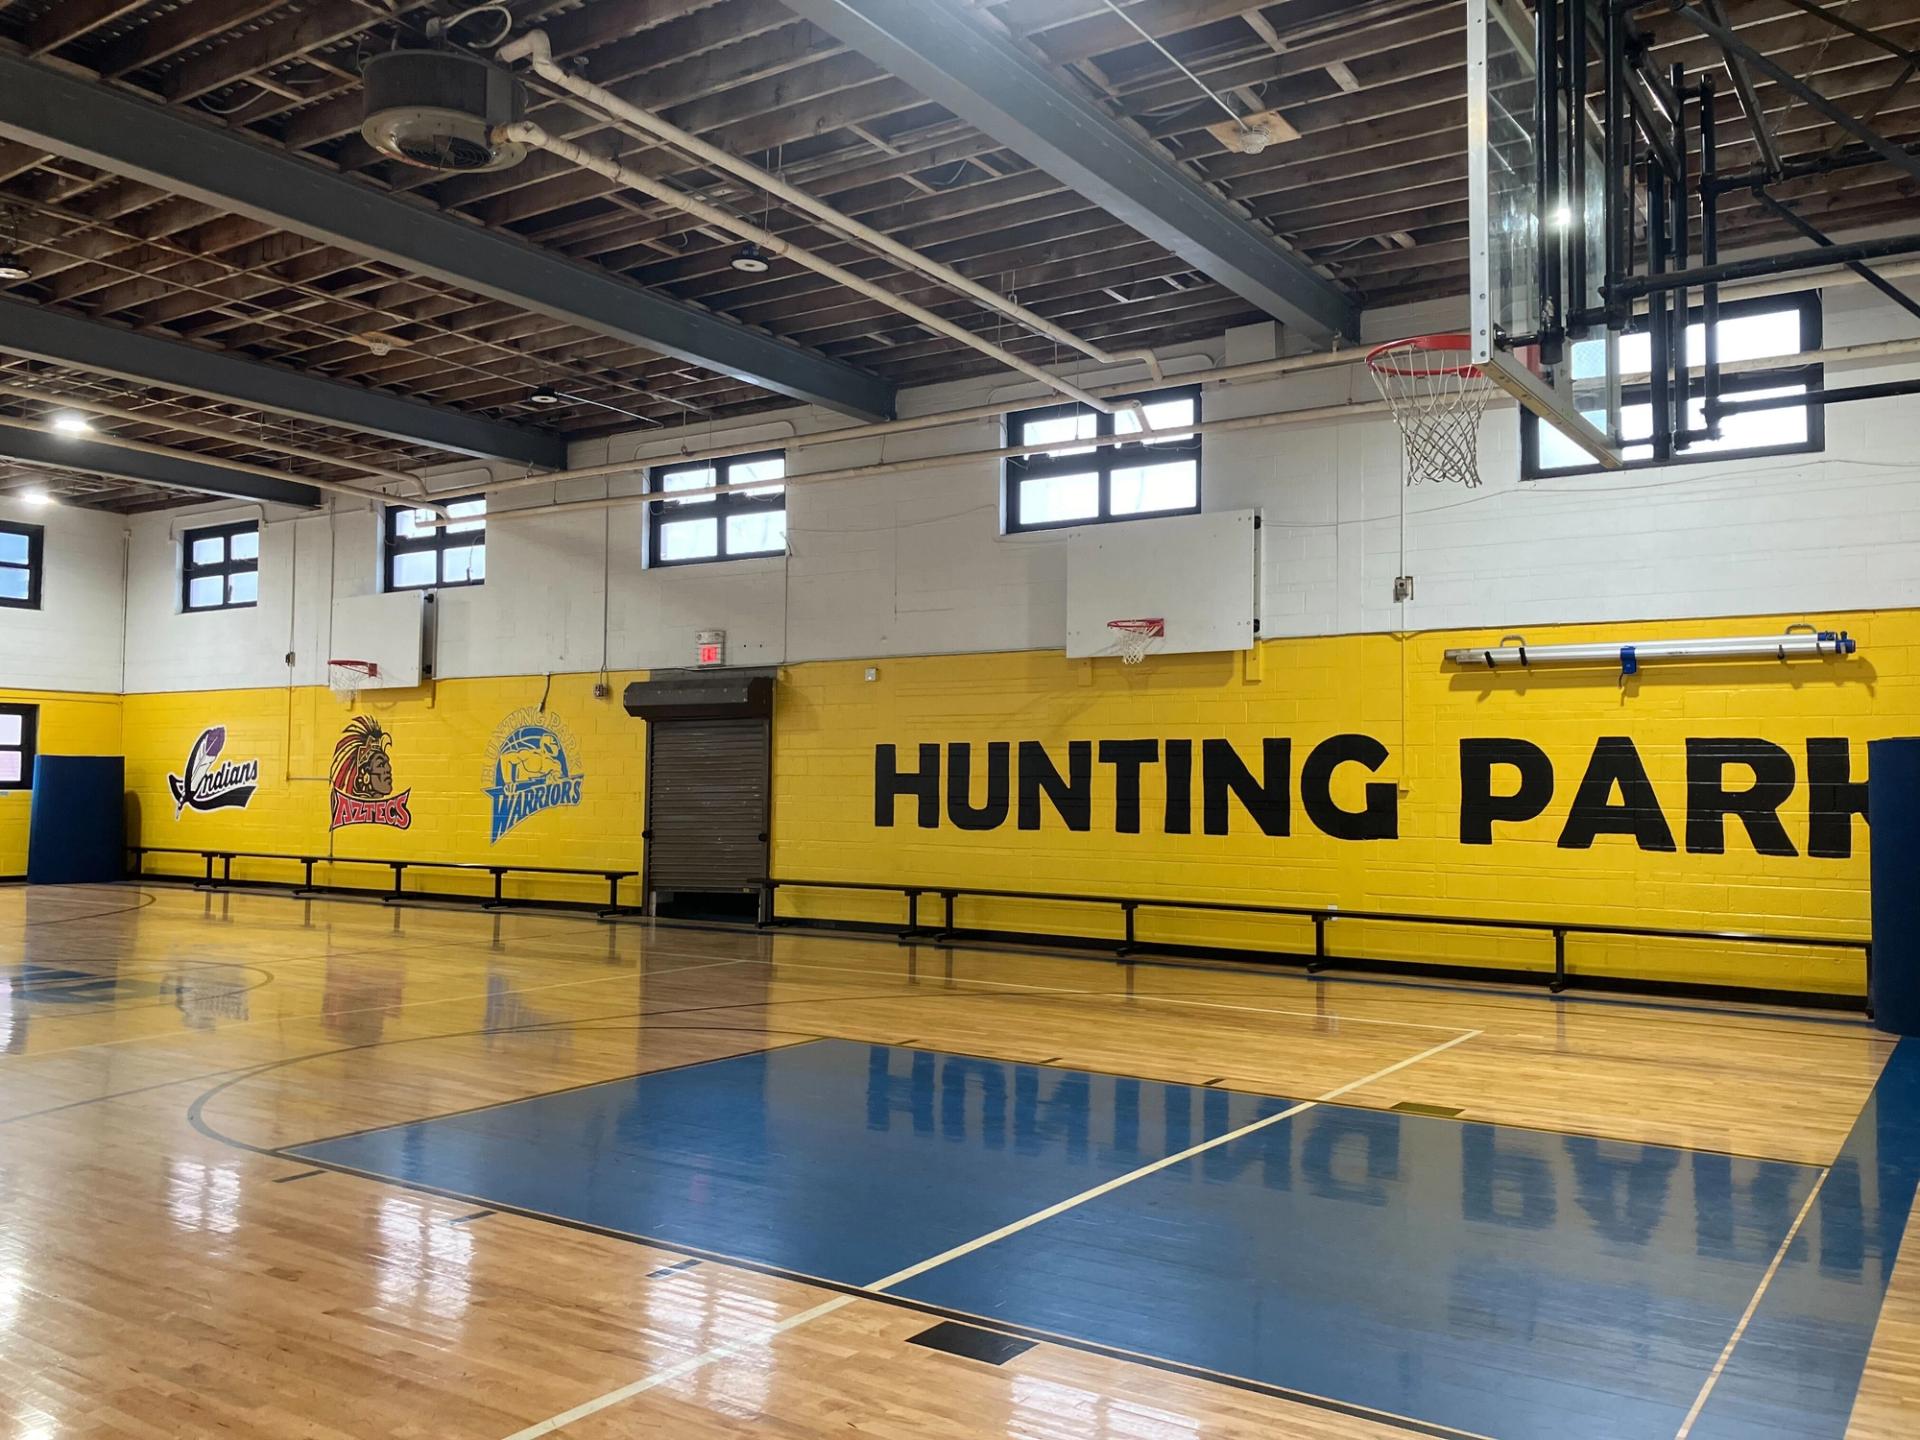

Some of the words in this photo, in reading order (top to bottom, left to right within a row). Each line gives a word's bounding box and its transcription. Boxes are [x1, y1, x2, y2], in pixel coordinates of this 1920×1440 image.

[168, 727, 258, 811] Indians
[875, 735, 1398, 840] HUNTING
[332, 791, 409, 828] AZTECS
[485, 778, 583, 844] WARRIORS
